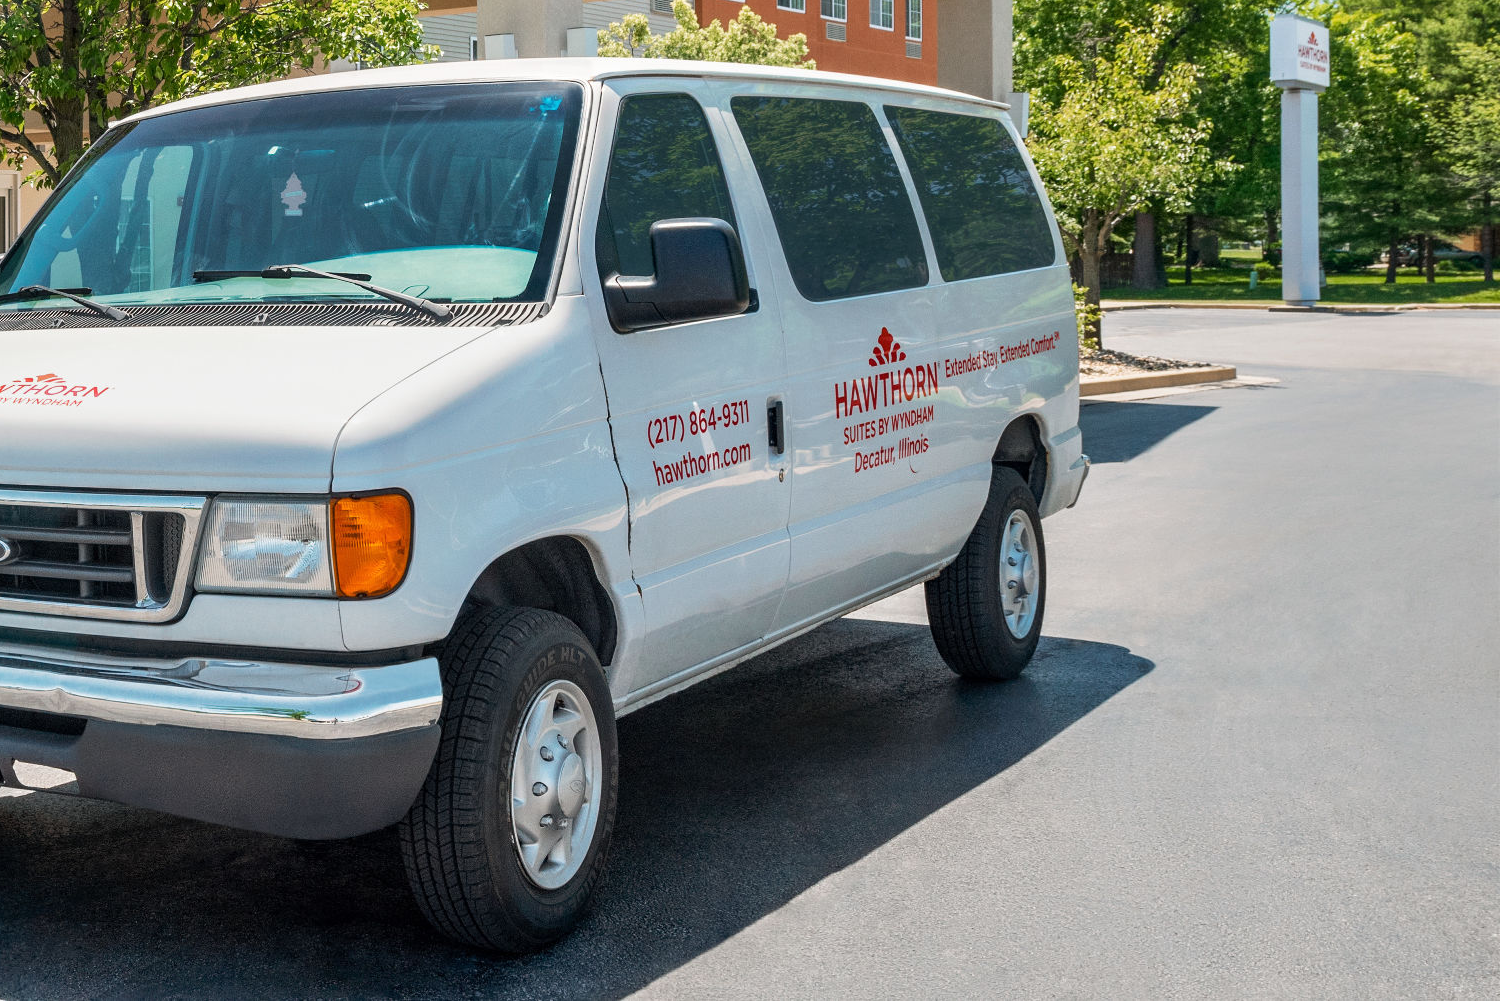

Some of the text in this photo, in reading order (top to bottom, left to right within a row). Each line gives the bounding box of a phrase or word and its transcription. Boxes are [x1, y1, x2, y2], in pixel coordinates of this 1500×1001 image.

[945, 353, 982, 378] Extended
[1000, 339, 1031, 364] Extended
[12, 398, 83, 407] WYNDHAM
[835, 362, 939, 419] HAWTHORN
[647, 399, 750, 449] (217) 864-9311
[843, 405, 934, 445] SUITES BY WYNDHAM
[652, 442, 751, 487] hawthorn.com
[854, 433, 929, 473] Decatur, Illinois
